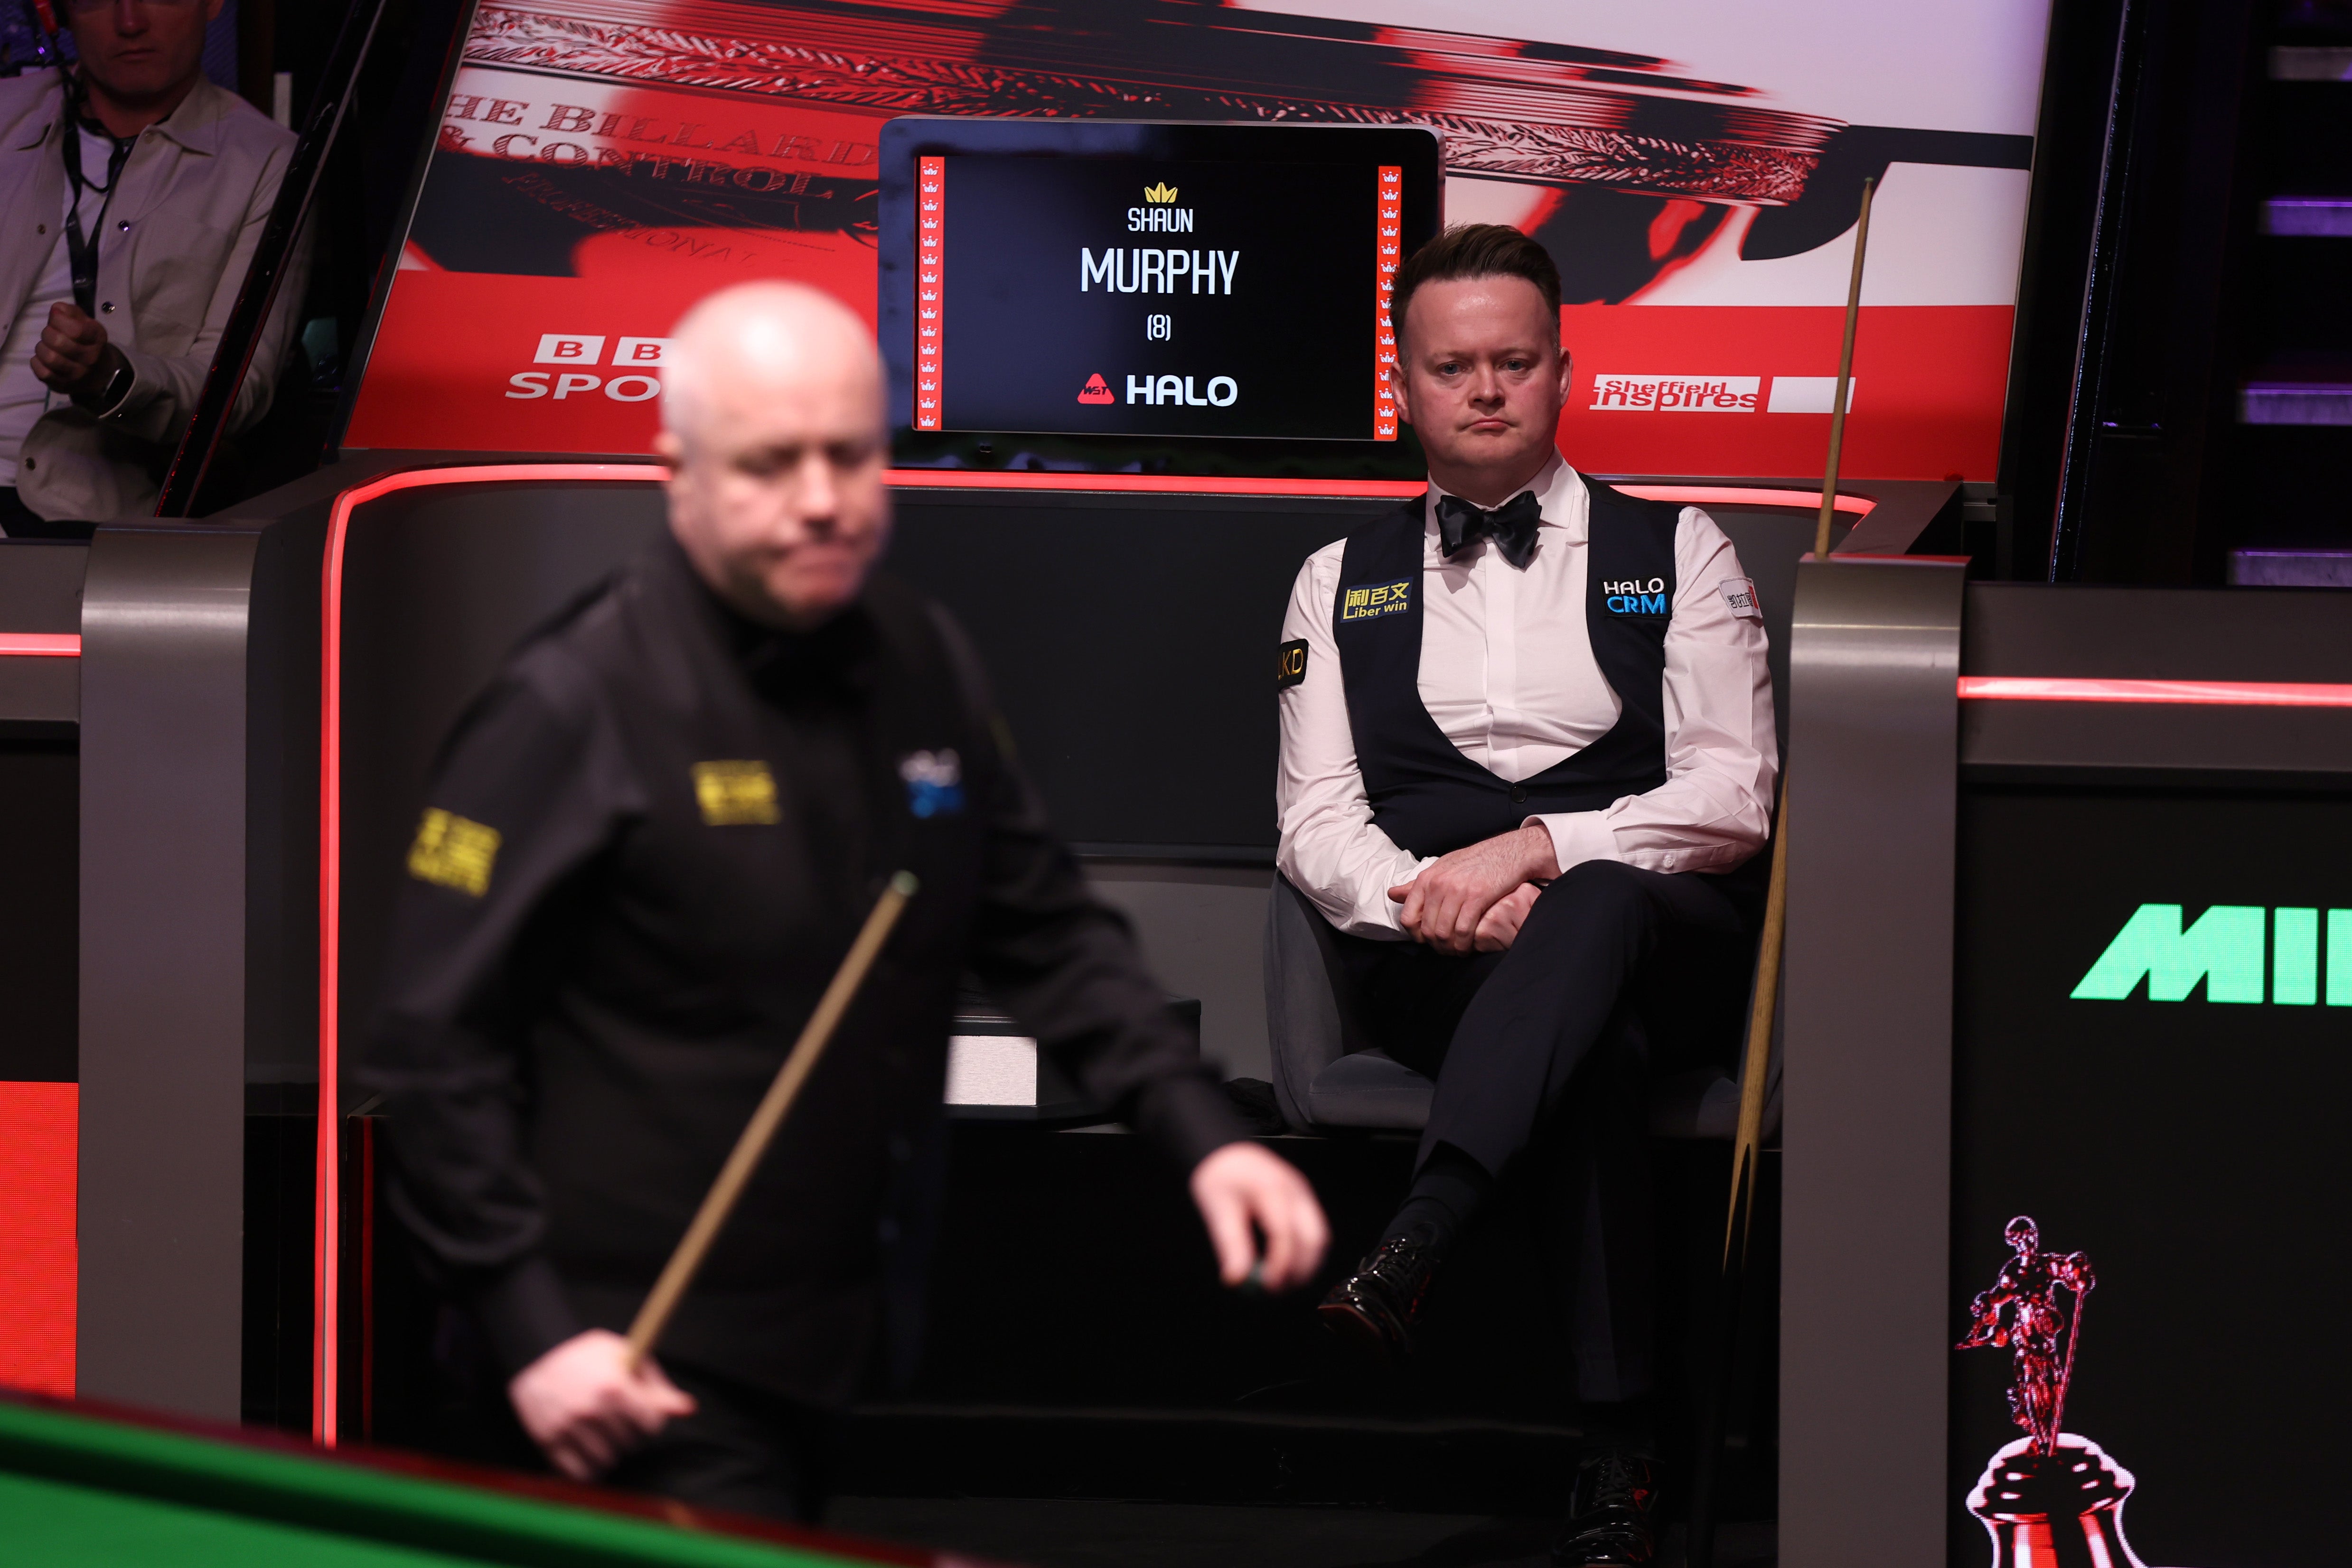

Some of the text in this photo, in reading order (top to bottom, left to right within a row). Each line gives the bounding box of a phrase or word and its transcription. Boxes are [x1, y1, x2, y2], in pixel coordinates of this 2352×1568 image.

[492, 133, 834, 200] CONTROL
[1127, 207, 1193, 233] SHAUN
[1081, 247, 1239, 295] MURPHY
[1146, 314, 1171, 341] (8)
[1083, 374, 1238, 407] WST HALO
[1591, 389, 1757, 411] inspires
[1605, 380, 1727, 395] Sheffield
[1349, 582, 1409, 607] 利百文
[1603, 578, 1665, 594] HALO
[1342, 589, 1407, 619] Liber win
[1607, 593, 1667, 614] CRM
